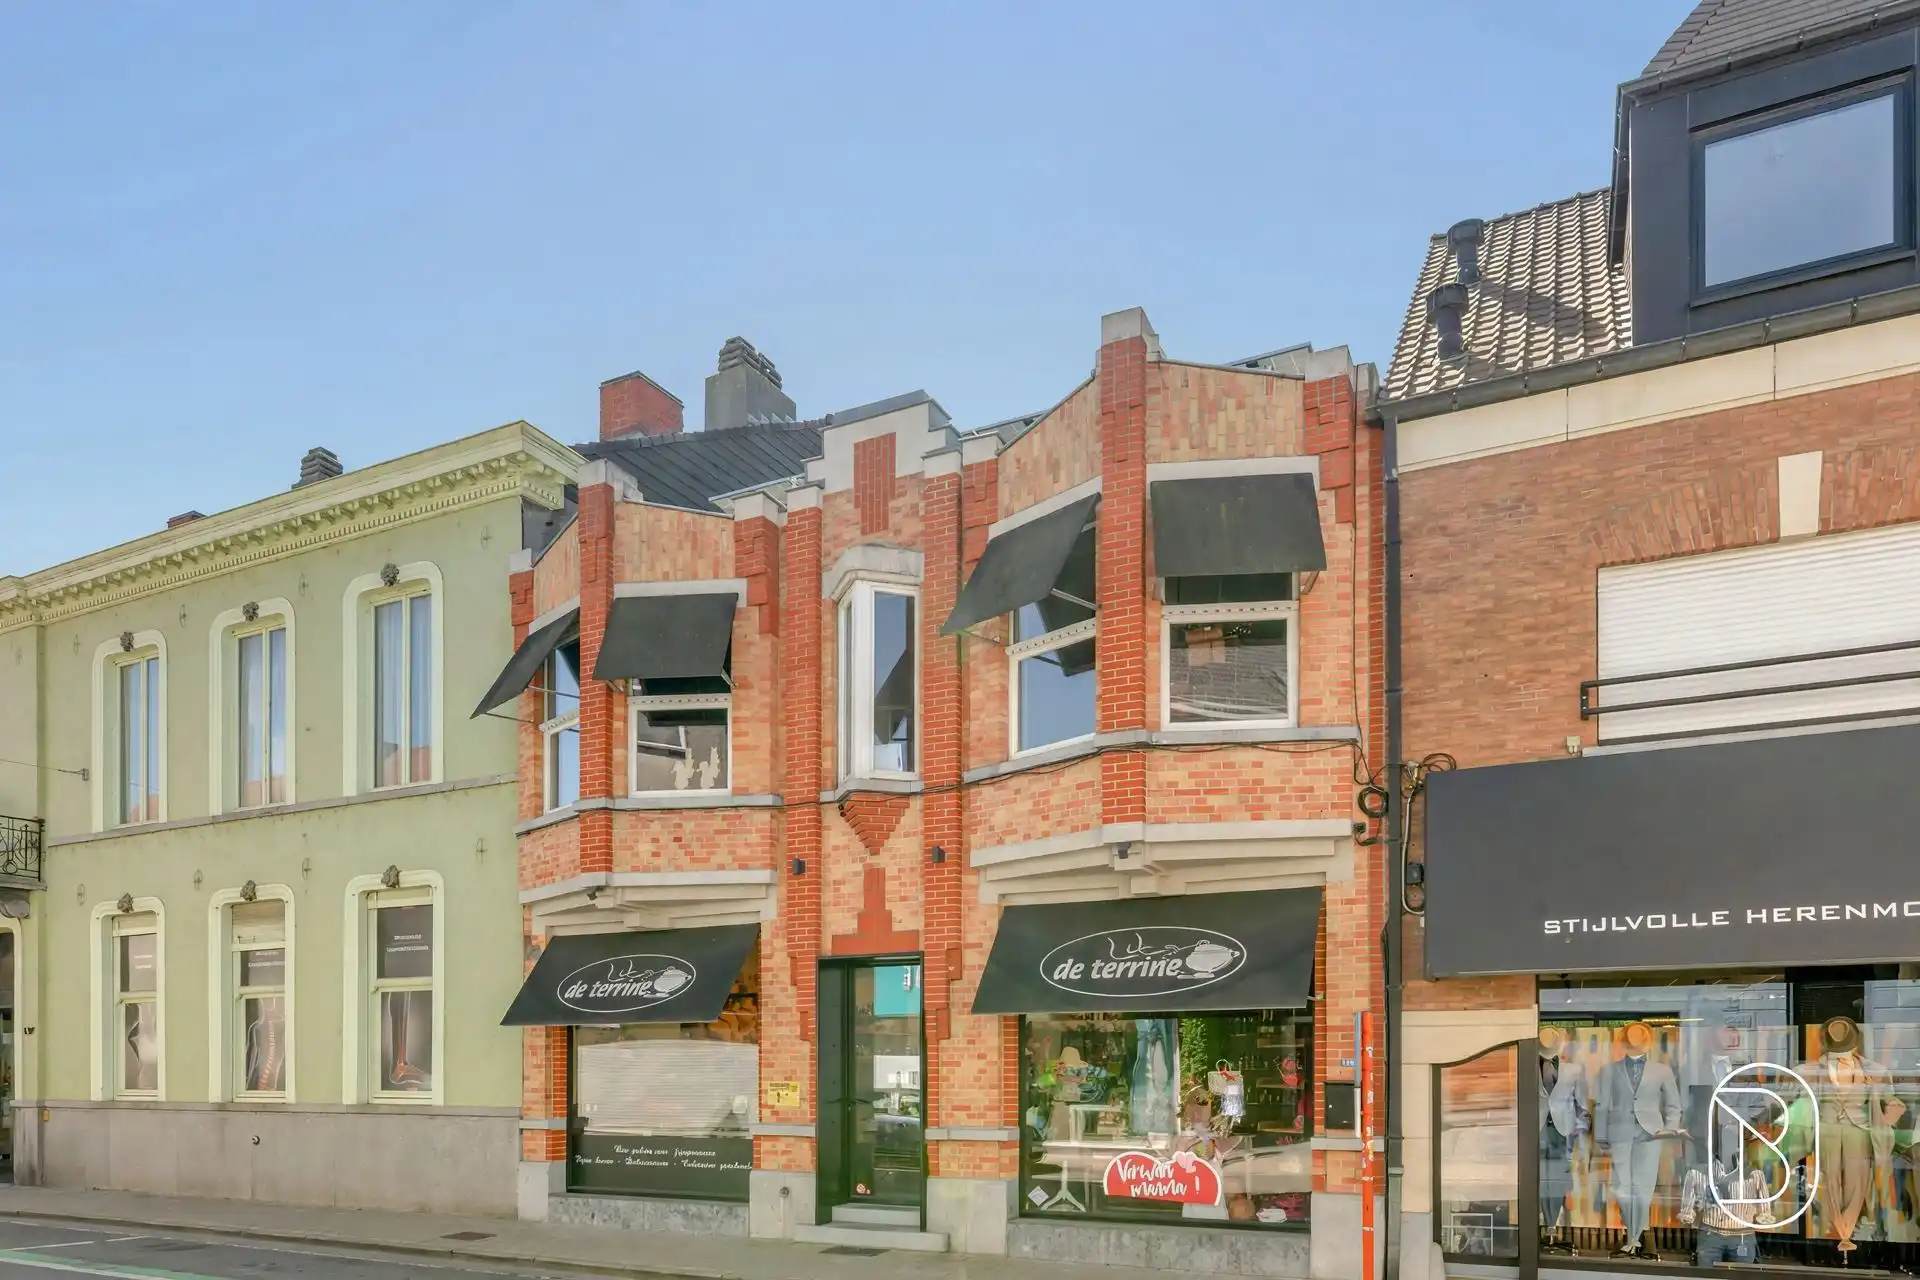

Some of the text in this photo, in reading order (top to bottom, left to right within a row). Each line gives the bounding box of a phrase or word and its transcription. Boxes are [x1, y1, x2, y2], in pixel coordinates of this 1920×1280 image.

[1544, 910, 1730, 934] STIJLVOLLE
[1053, 956, 1183, 980] de terrine
[564, 978, 653, 999] de terrine
